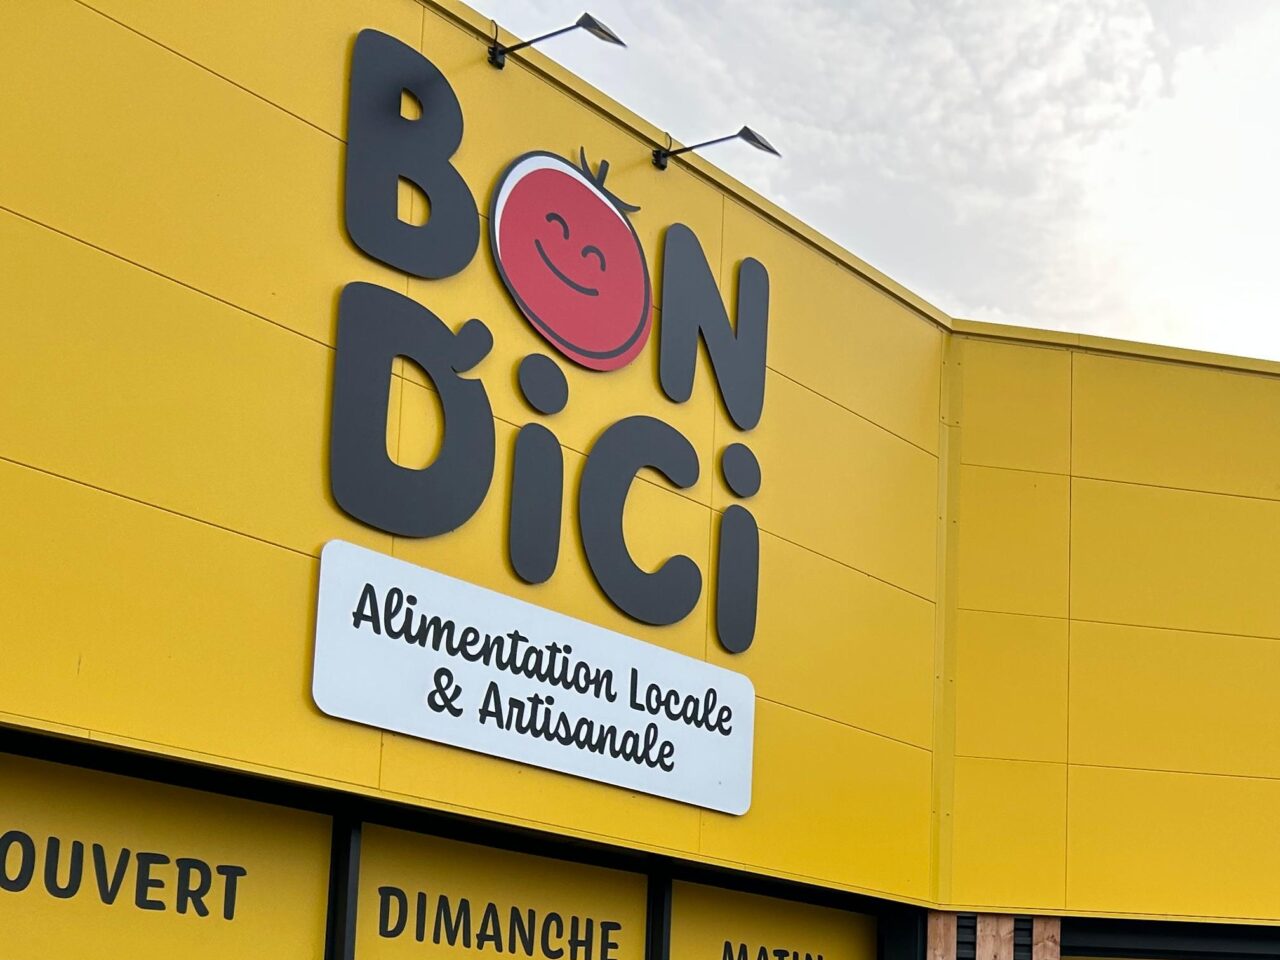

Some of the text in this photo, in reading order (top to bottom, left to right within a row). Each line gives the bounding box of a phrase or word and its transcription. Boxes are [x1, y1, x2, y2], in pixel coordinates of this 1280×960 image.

[352, 582, 732, 736] Alimentation Locale
[427, 667, 676, 773] & Artisanale
[0, 829, 248, 921] OUVERT
